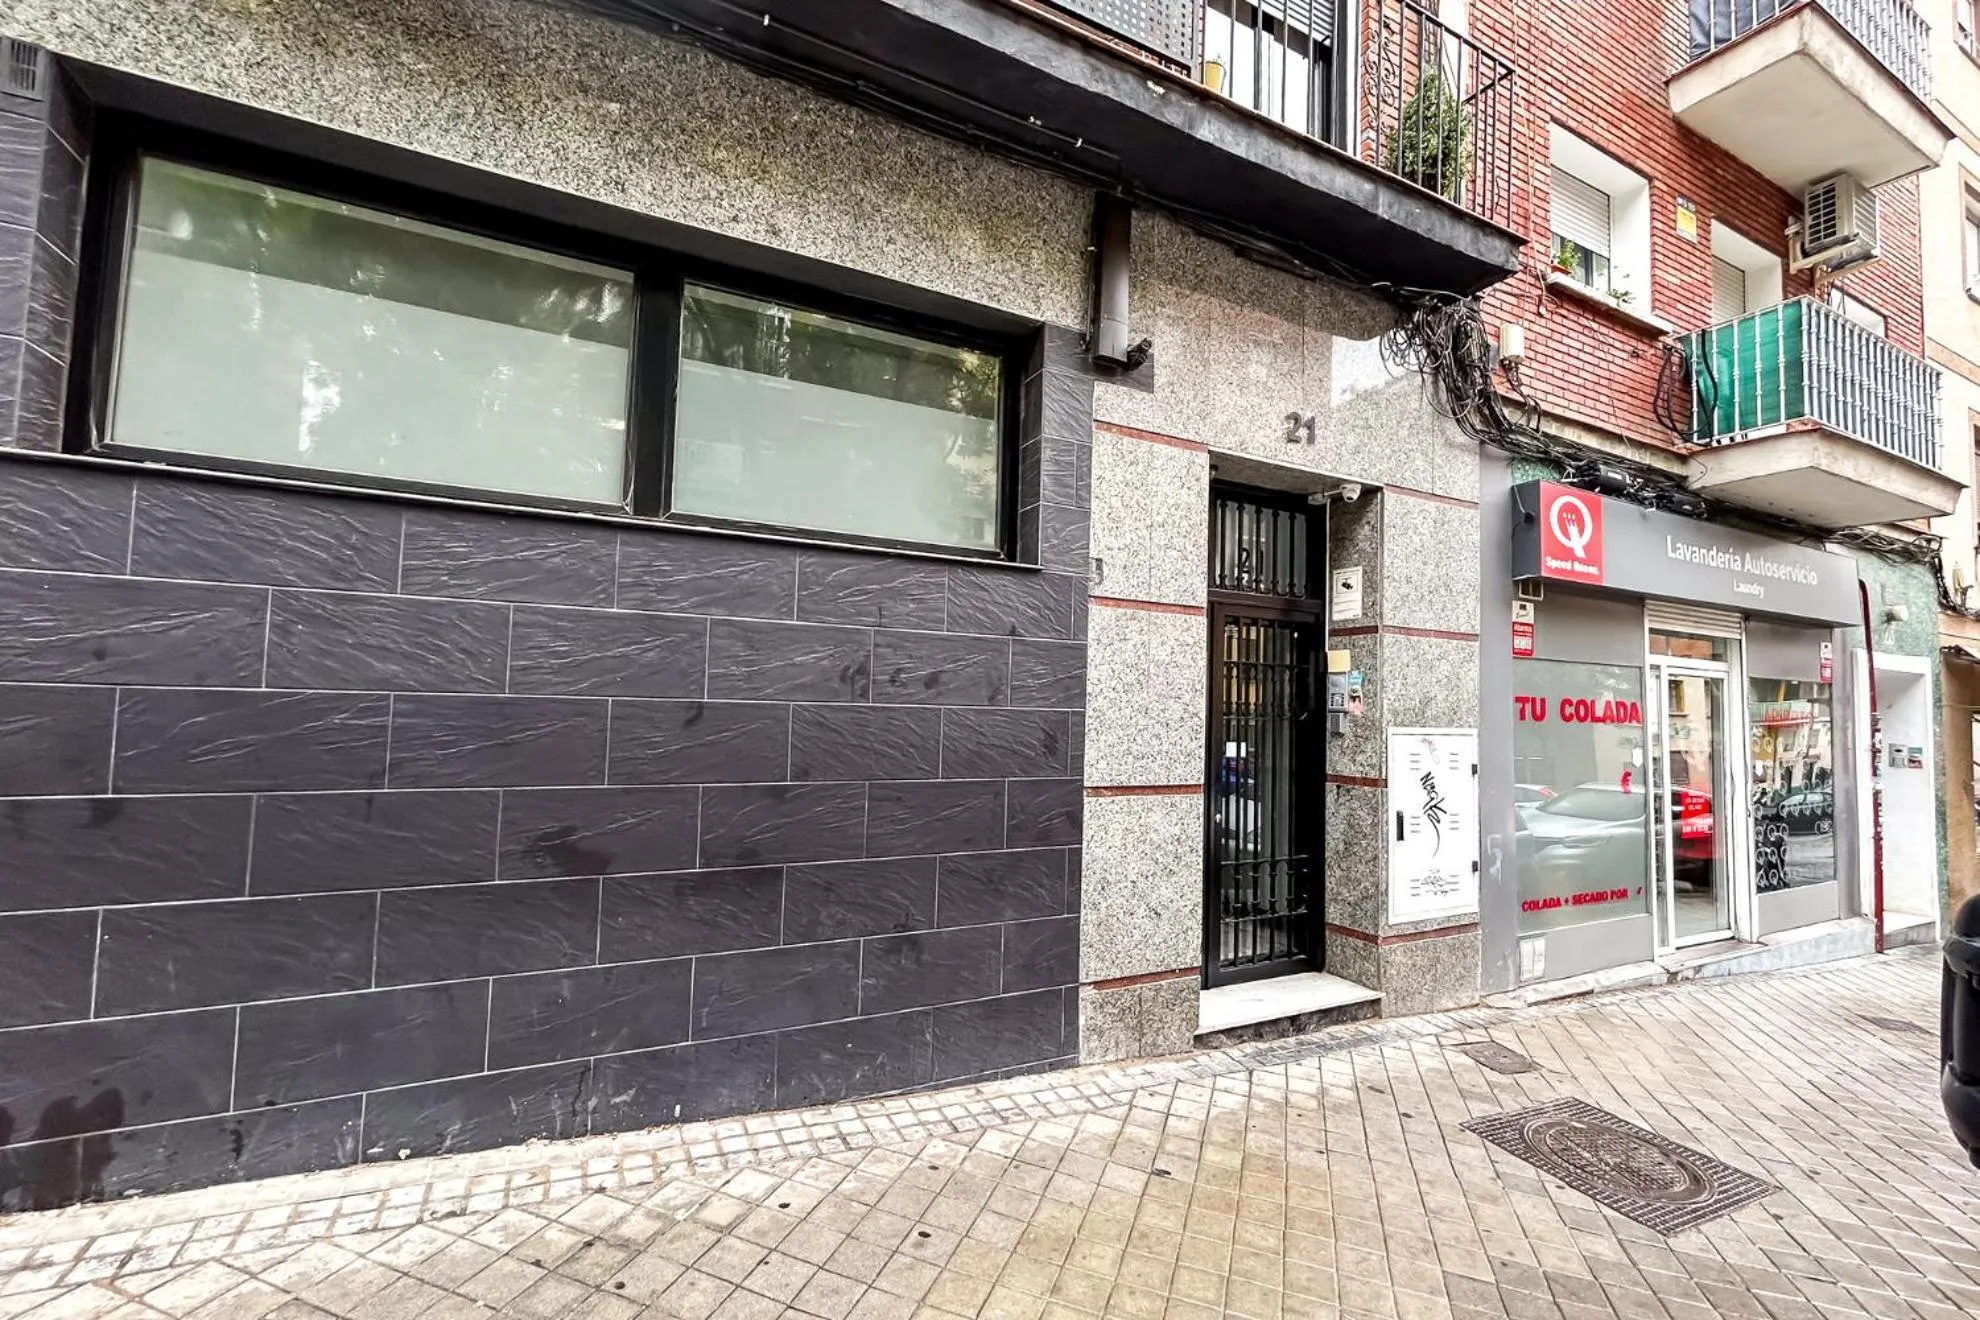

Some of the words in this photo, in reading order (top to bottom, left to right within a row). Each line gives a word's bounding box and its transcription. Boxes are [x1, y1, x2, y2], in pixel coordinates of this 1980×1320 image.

[1285, 411, 1316, 444] 21
[1666, 534, 1742, 572] Lavandería
[1744, 551, 1818, 586] Autoservicio
[1733, 579, 1765, 599] Laundry
[1514, 696, 1547, 722] TU
[1559, 698, 1642, 724] COLADA
[1521, 897, 1562, 912] COLADA
[1571, 890, 1609, 905] SECADO
[1610, 887, 1628, 900] POR
